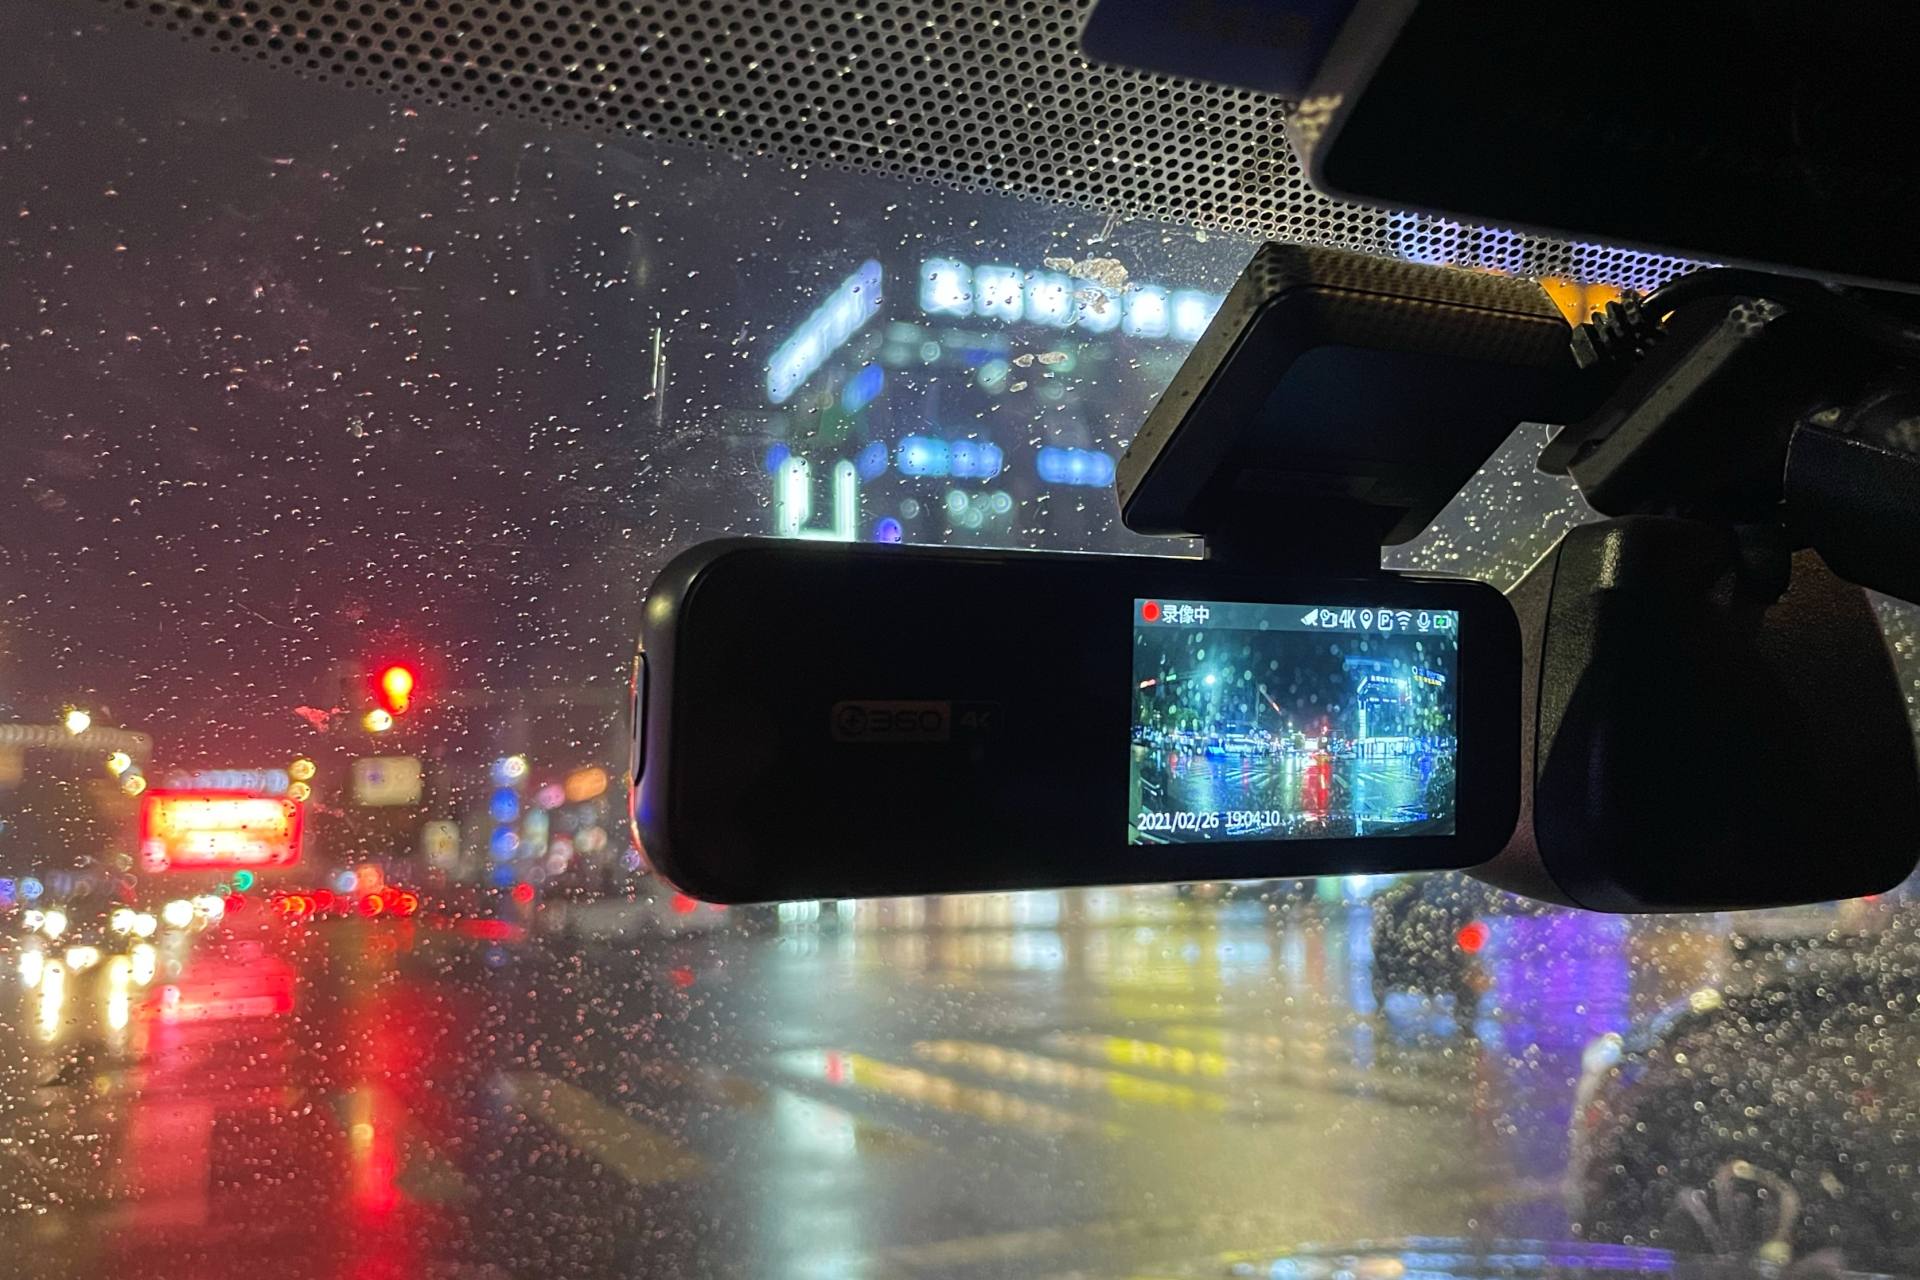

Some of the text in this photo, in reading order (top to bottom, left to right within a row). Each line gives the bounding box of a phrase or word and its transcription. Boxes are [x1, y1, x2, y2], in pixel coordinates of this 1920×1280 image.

[1162, 604, 1210, 624] 录像中
[1339, 609, 1356, 628] 4K
[1137, 810, 1280, 832] 2021/02/26 19:04:10
